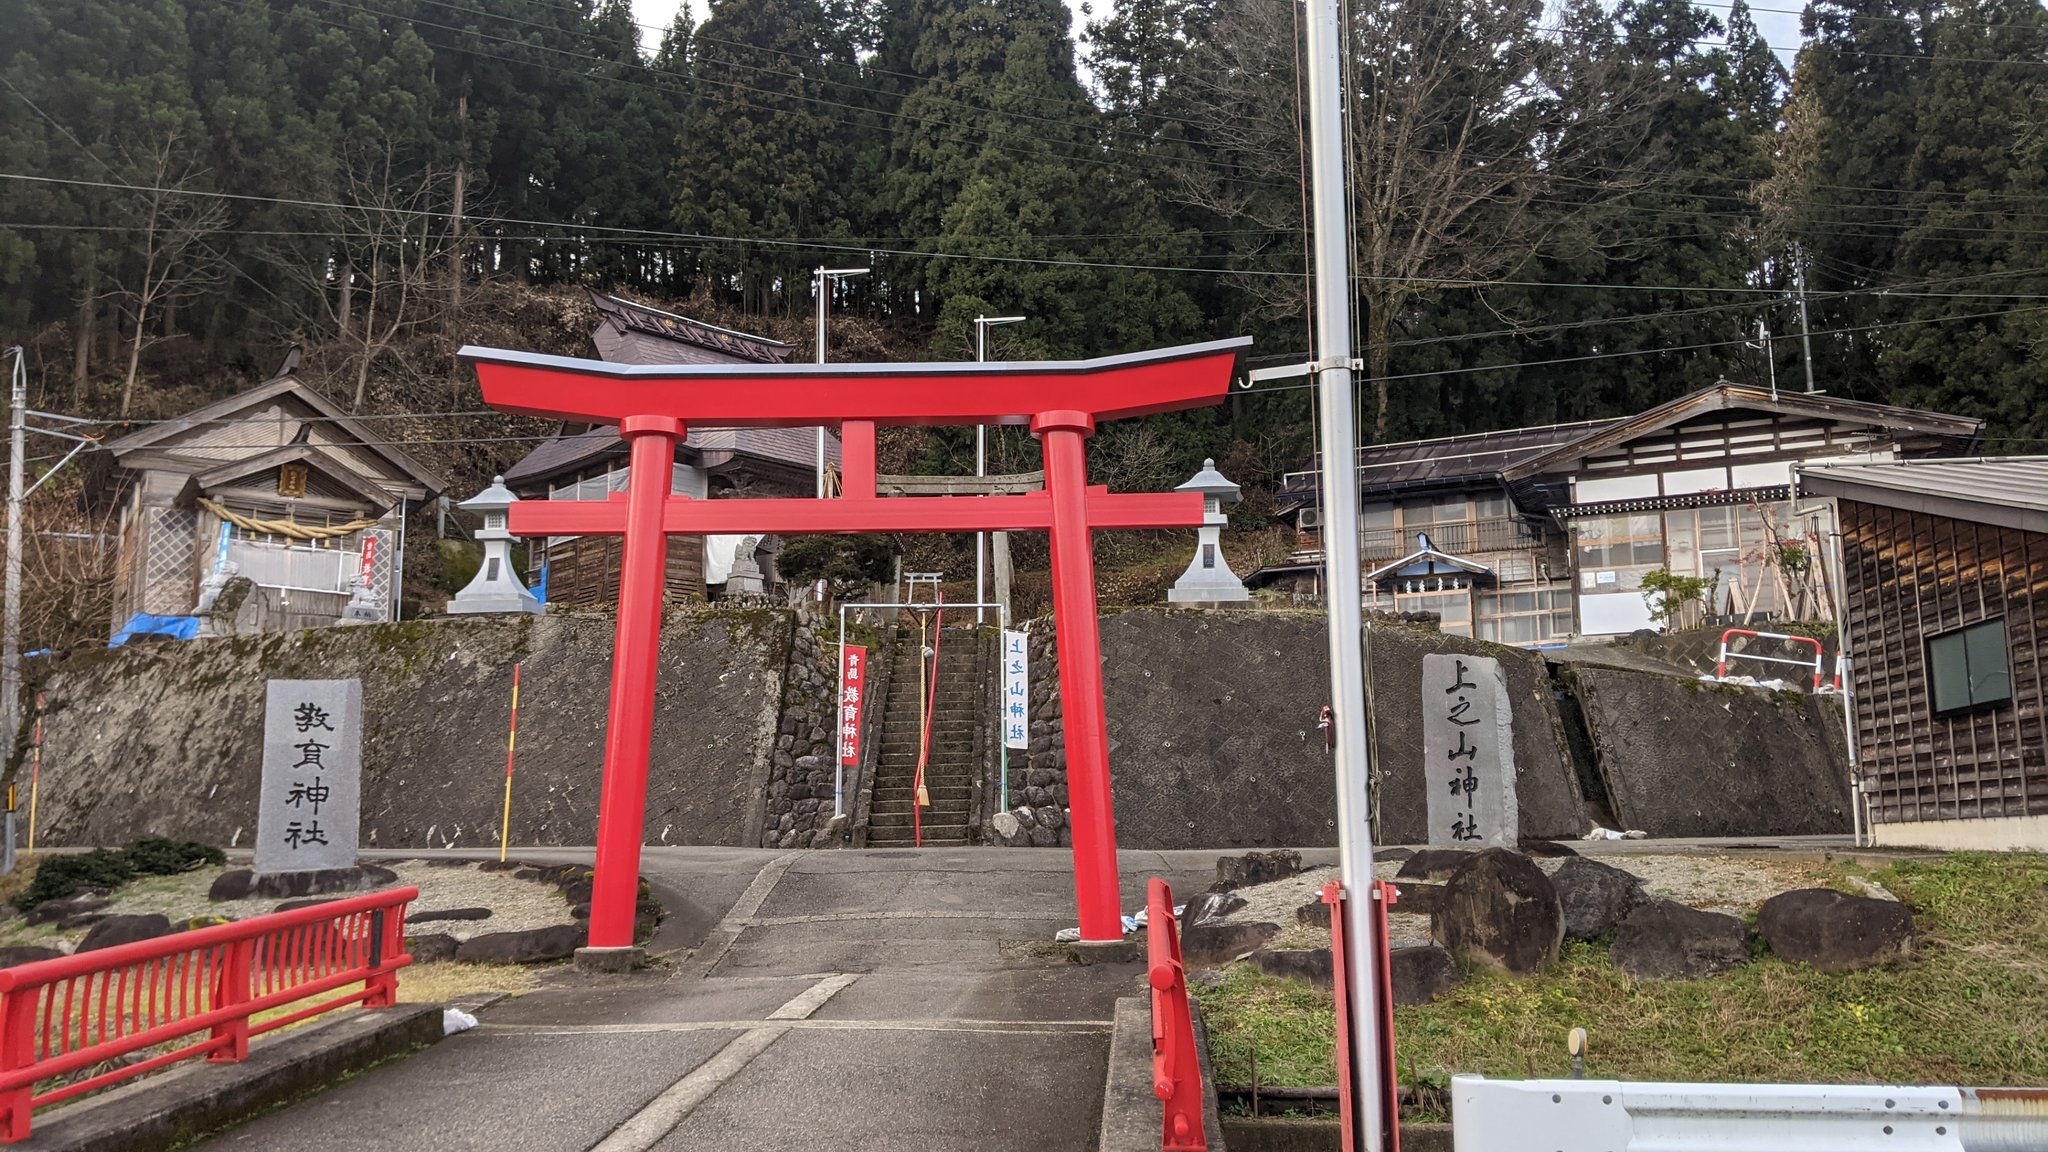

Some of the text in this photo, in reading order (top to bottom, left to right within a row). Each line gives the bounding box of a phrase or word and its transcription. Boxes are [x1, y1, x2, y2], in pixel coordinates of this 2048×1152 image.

[1446, 660, 1482, 841] 上之山神社
